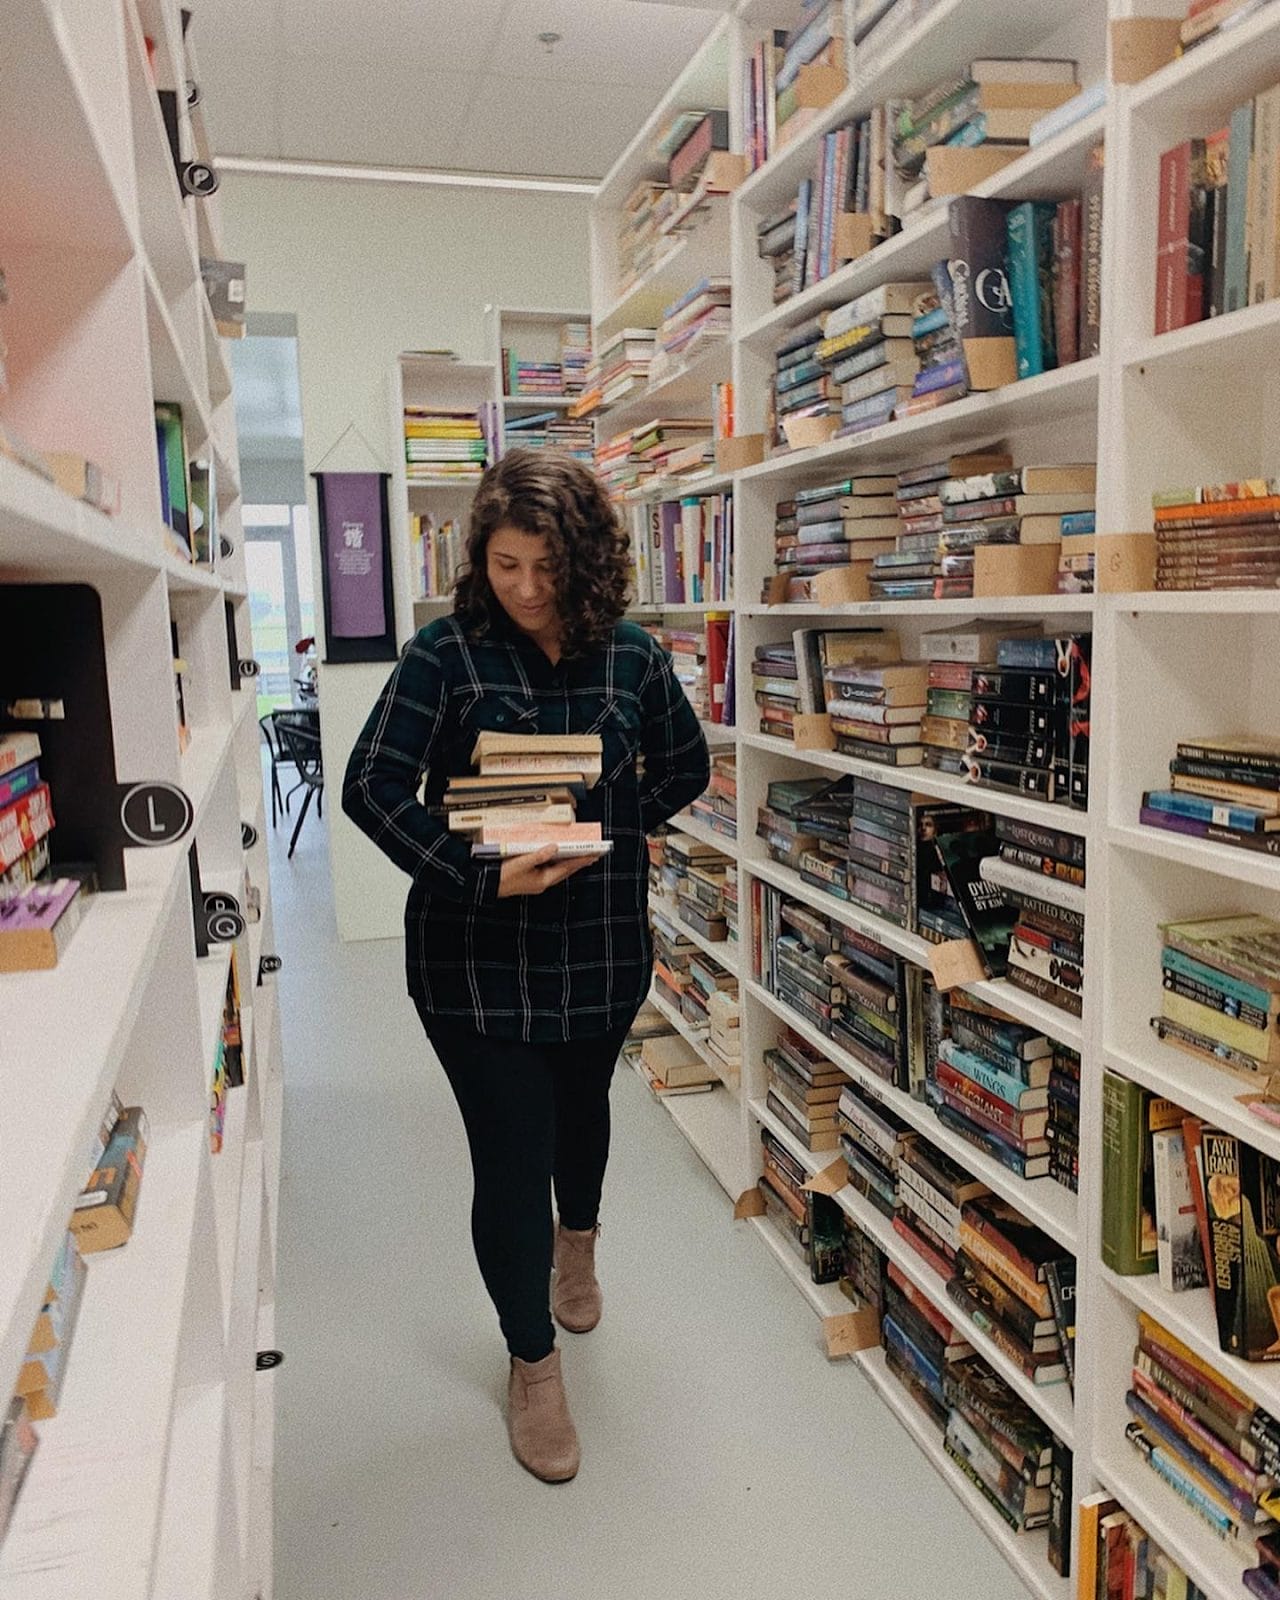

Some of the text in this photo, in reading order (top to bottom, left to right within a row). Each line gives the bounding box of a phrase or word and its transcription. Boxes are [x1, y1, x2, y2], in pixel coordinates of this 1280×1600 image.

[147, 795, 165, 832] L
[967, 879, 1001, 896] DYIN
[975, 901, 988, 911] BY
[1060, 907, 1084, 927] BONE
[215, 917, 236, 937] Q
[973, 1064, 1007, 1097] WINGS
[1211, 1138, 1233, 1155] AYN
[1209, 1156, 1236, 1175] RAND
